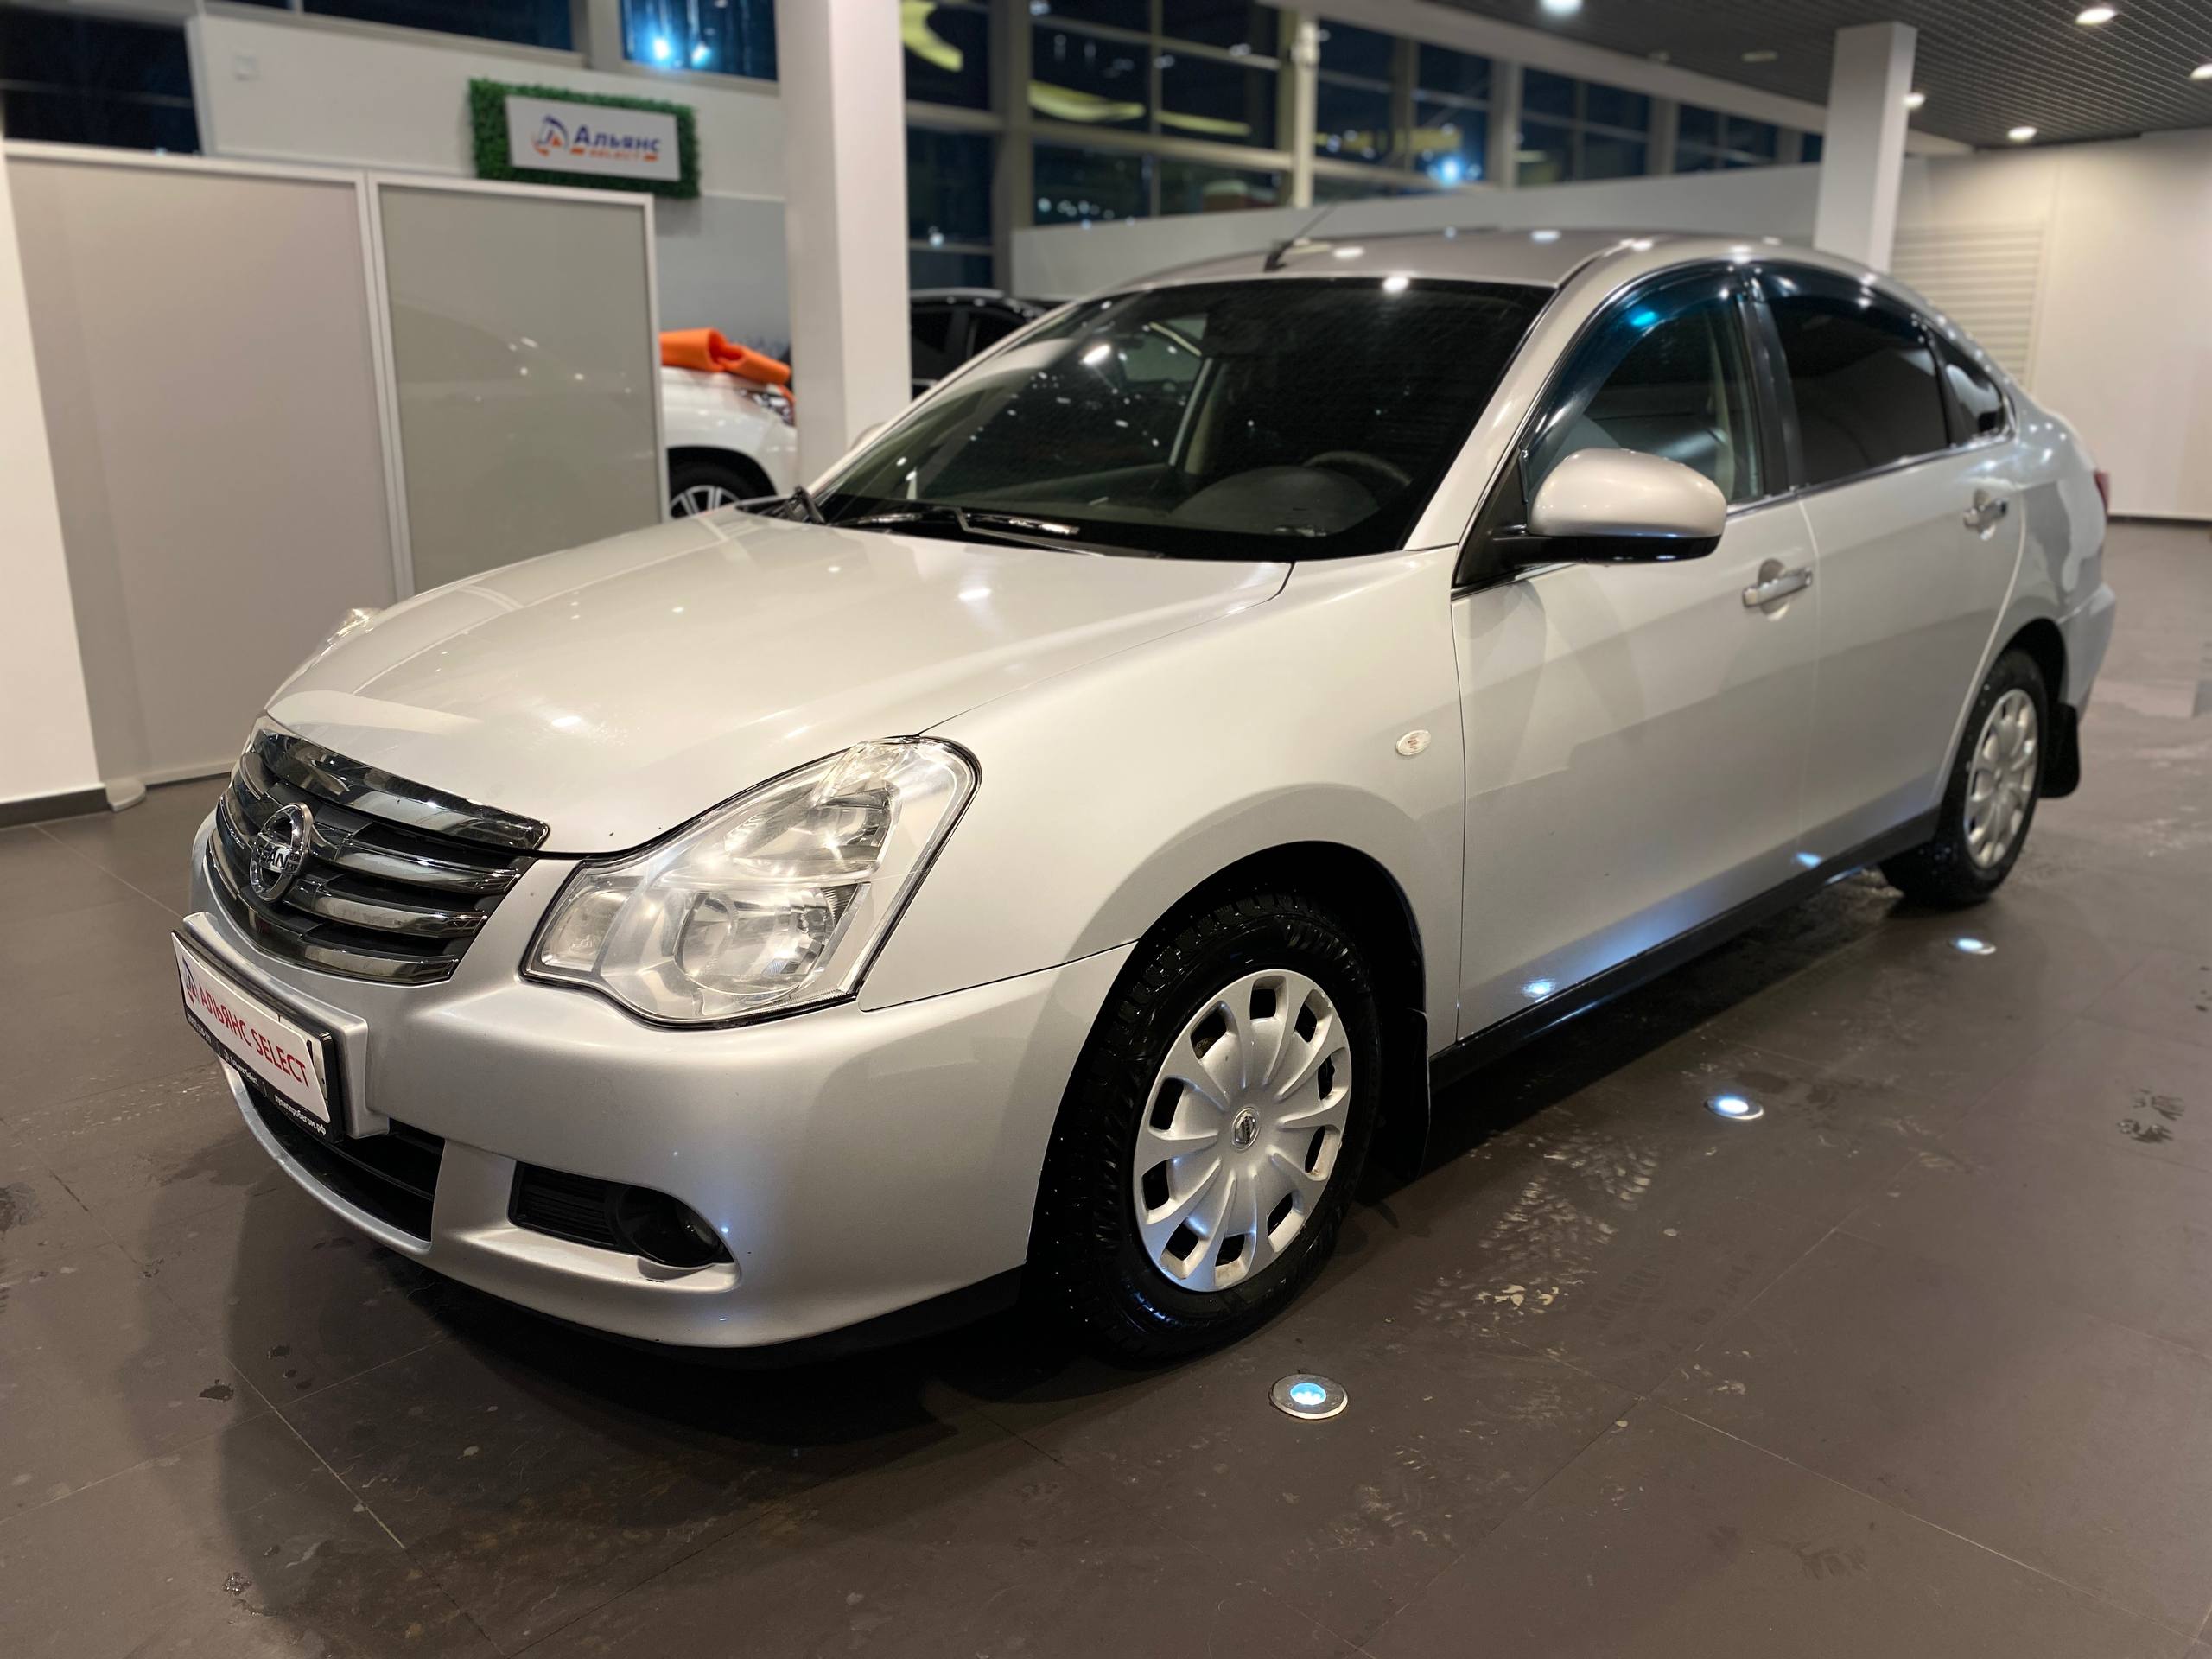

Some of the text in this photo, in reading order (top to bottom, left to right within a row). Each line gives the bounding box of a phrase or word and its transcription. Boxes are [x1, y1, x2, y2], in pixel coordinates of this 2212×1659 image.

[574, 124, 659, 152] Альянс
[199, 983, 252, 1048] АЛЬЯНС
[251, 1028, 309, 1089] SELECT
